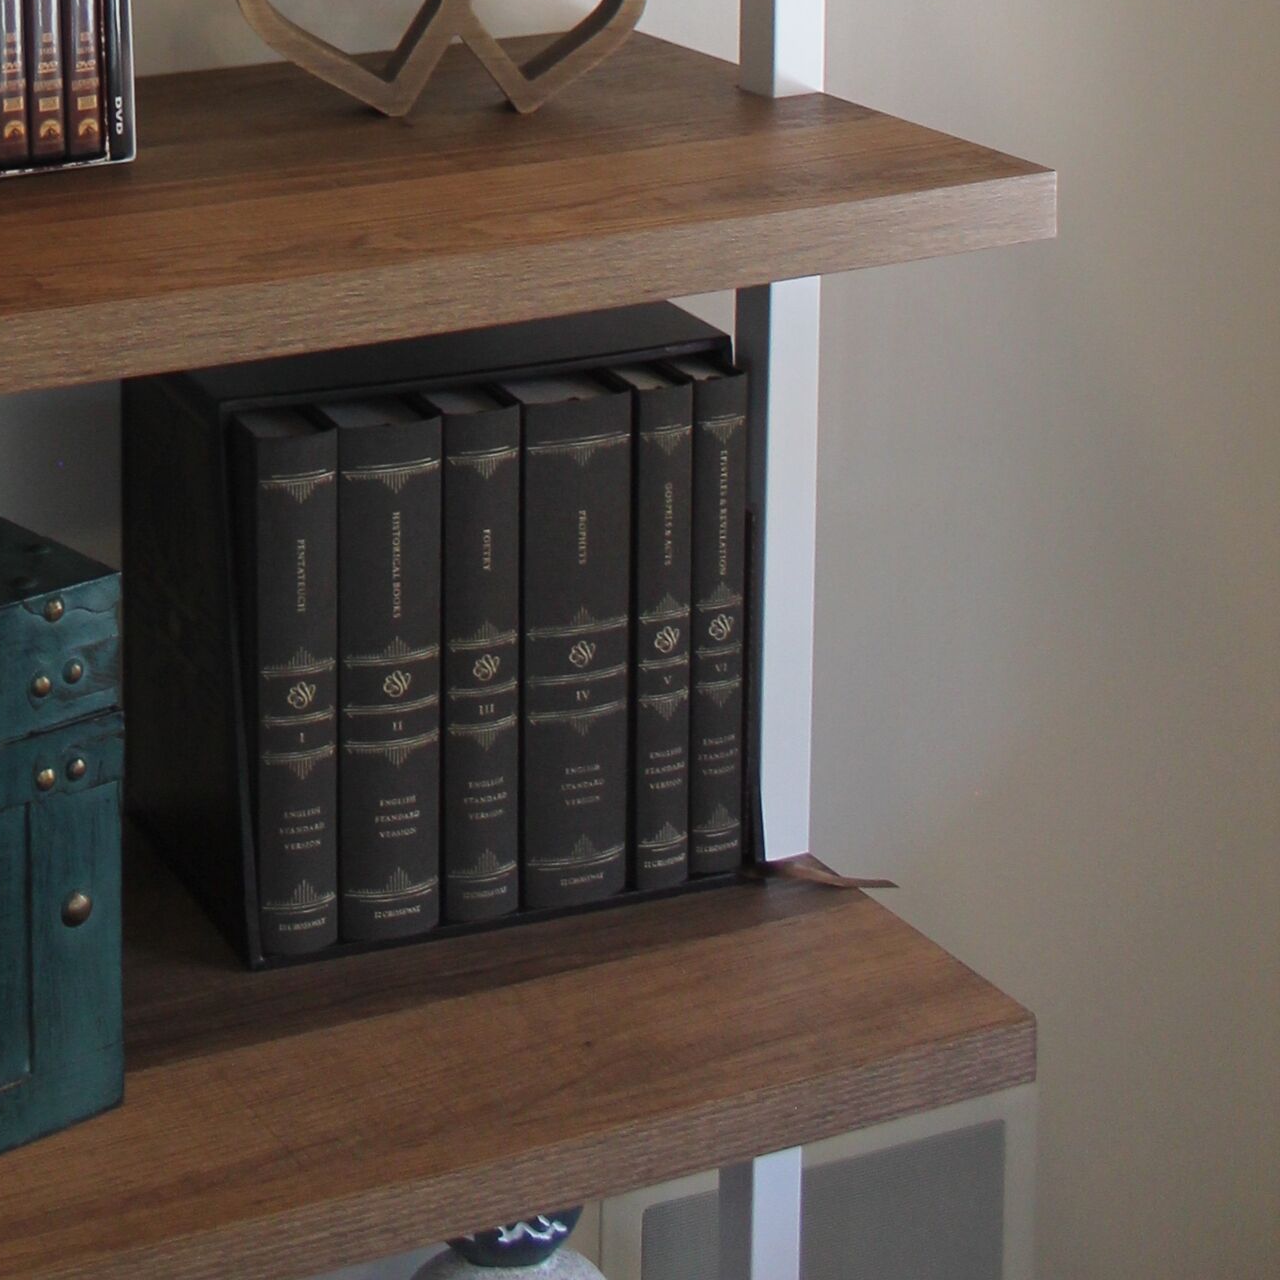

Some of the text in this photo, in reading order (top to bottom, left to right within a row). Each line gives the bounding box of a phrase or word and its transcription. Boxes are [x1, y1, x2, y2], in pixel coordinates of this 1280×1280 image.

[114, 95, 124, 136] DVD
[664, 482, 674, 527] GOSPELS
[577, 509, 588, 566] PROPHETS
[718, 508, 729, 576] REVELATION
[481, 528, 492, 572] POETRY
[391, 511, 402, 619] HISTORICAL BOOKS
[714, 663, 728, 673] VI
[663, 675, 673, 685] V
[575, 689, 591, 701] IV
[478, 703, 495, 716] III
[391, 721, 404, 731] II
[298, 731, 306, 743] I
[379, 794, 417, 807] ENGLISH
[374, 809, 421, 823] STANDARD
[379, 826, 417, 839] VERSION
